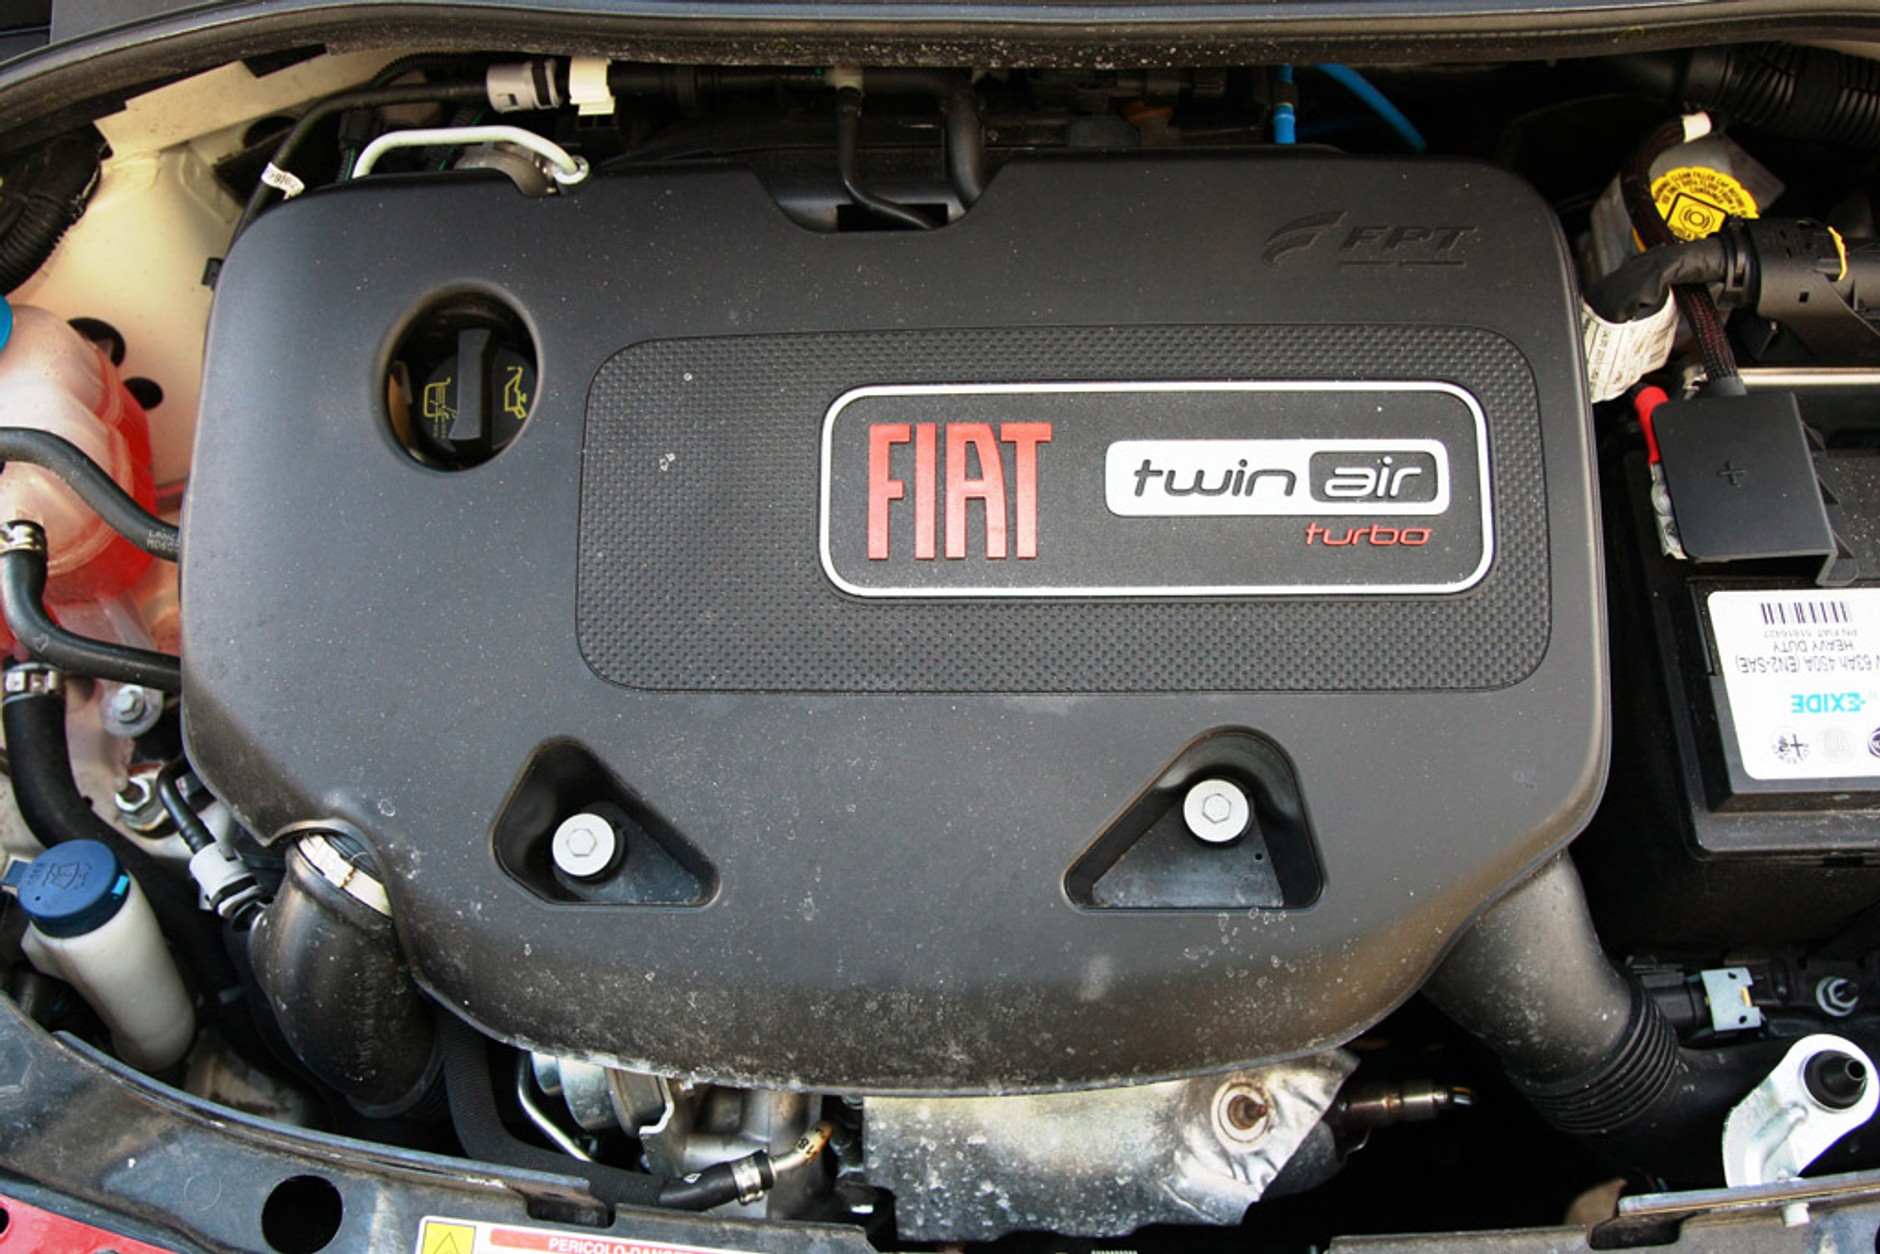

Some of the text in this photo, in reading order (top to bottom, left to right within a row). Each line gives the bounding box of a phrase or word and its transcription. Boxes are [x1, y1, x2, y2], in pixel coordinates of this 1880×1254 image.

[1134, 456, 1422, 497] twin air
[868, 422, 1053, 561] FIAT
[1305, 522, 1433, 547] turbo
[1773, 638, 1854, 653] HEAVY DUTY
[1790, 692, 1864, 713] EXIDE
